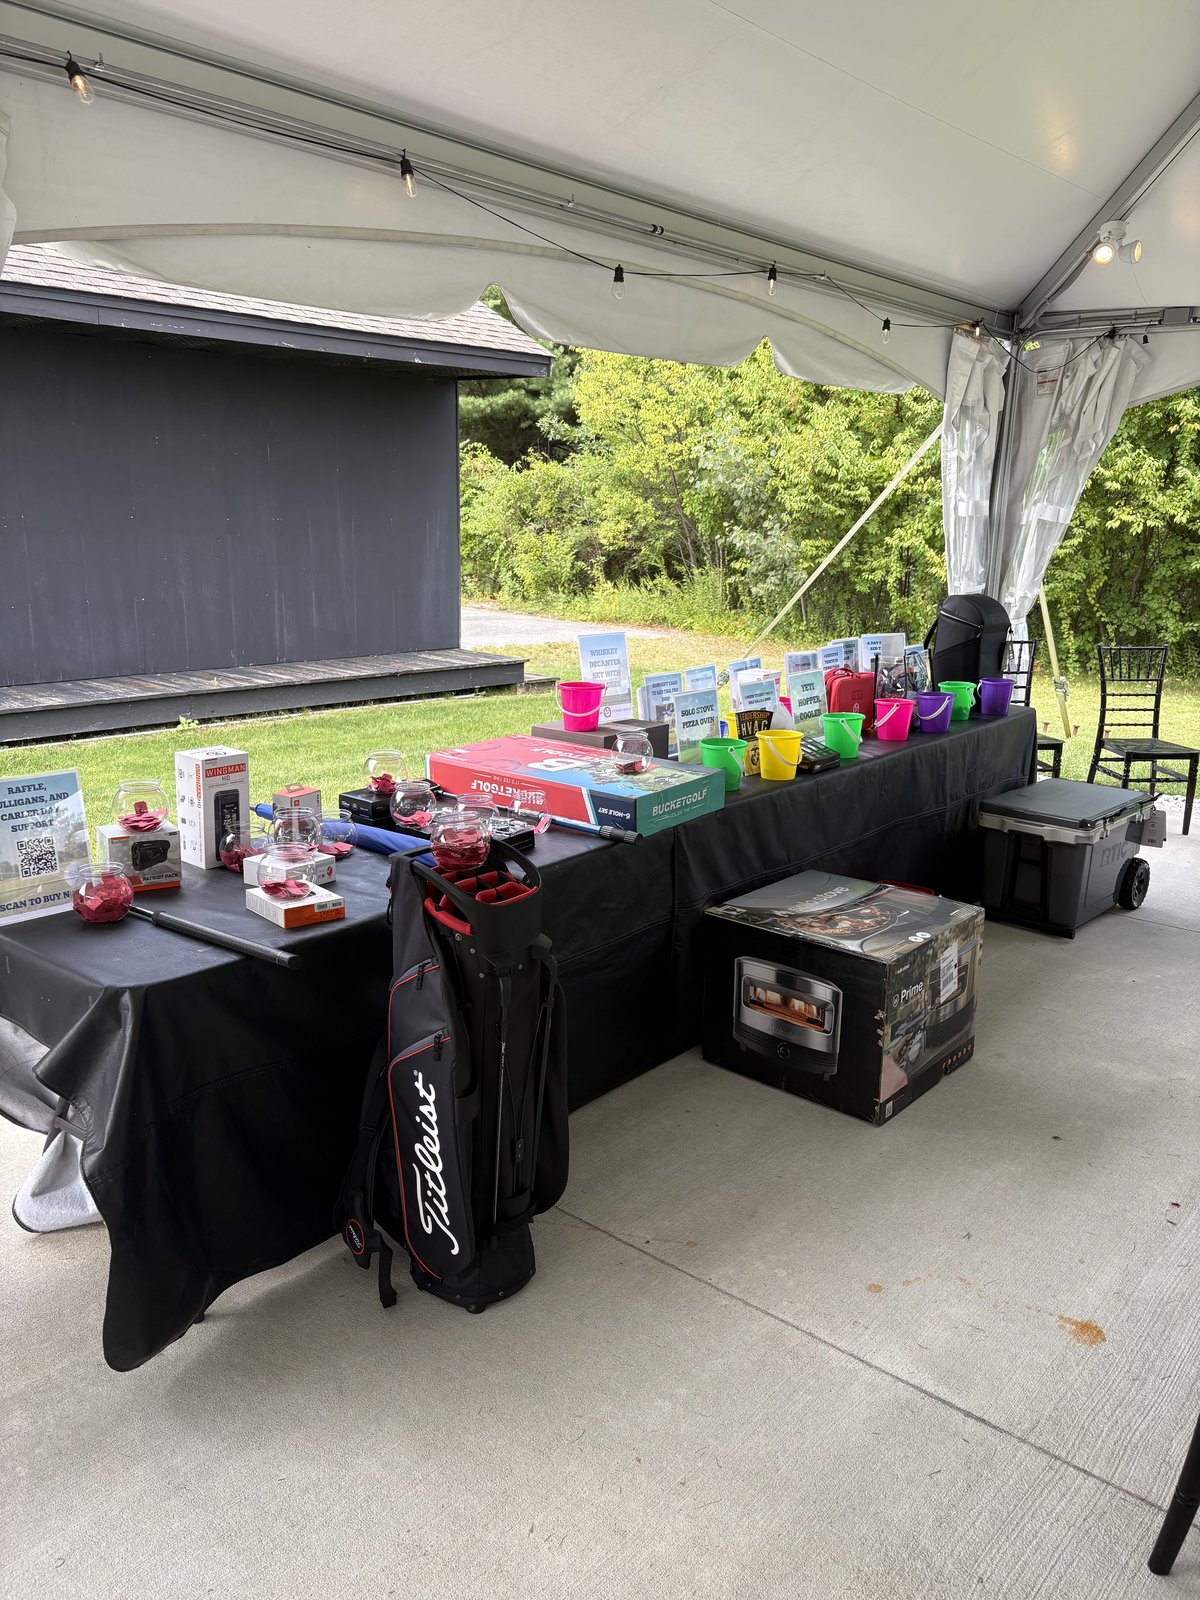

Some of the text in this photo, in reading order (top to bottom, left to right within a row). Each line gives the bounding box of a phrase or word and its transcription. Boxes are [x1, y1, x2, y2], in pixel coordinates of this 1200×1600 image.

[589, 647, 618, 657] WHISKEY
[589, 658, 621, 668] DECANTER
[592, 669, 621, 679] SET WITH
[606, 681, 621, 689] SSES
[801, 682, 815, 692] YETI
[798, 695, 821, 707] HOPPER
[681, 704, 714, 717] SOLO STOVE
[739, 711, 769, 721] LEADERSHIP
[800, 709, 822, 720] COOLER
[682, 716, 715, 729] PIZZA OVEN
[741, 719, 768, 736] HVAC
[206, 763, 246, 778] WINGMAN
[7, 783, 47, 795] RAFFLE,
[0, 792, 69, 809] LLIGANS, AND
[652, 788, 707, 817] BUCKETGOLF
[40, 806, 60, 815] DAY
[608, 811, 631, 820] 6-HOLE
[0, 899, 26, 912] SCAN
[28, 897, 42, 906] TO
[43, 892, 61, 903] BUY
[900, 981, 924, 1004] Prime
[412, 1071, 459, 1256] Titleist
